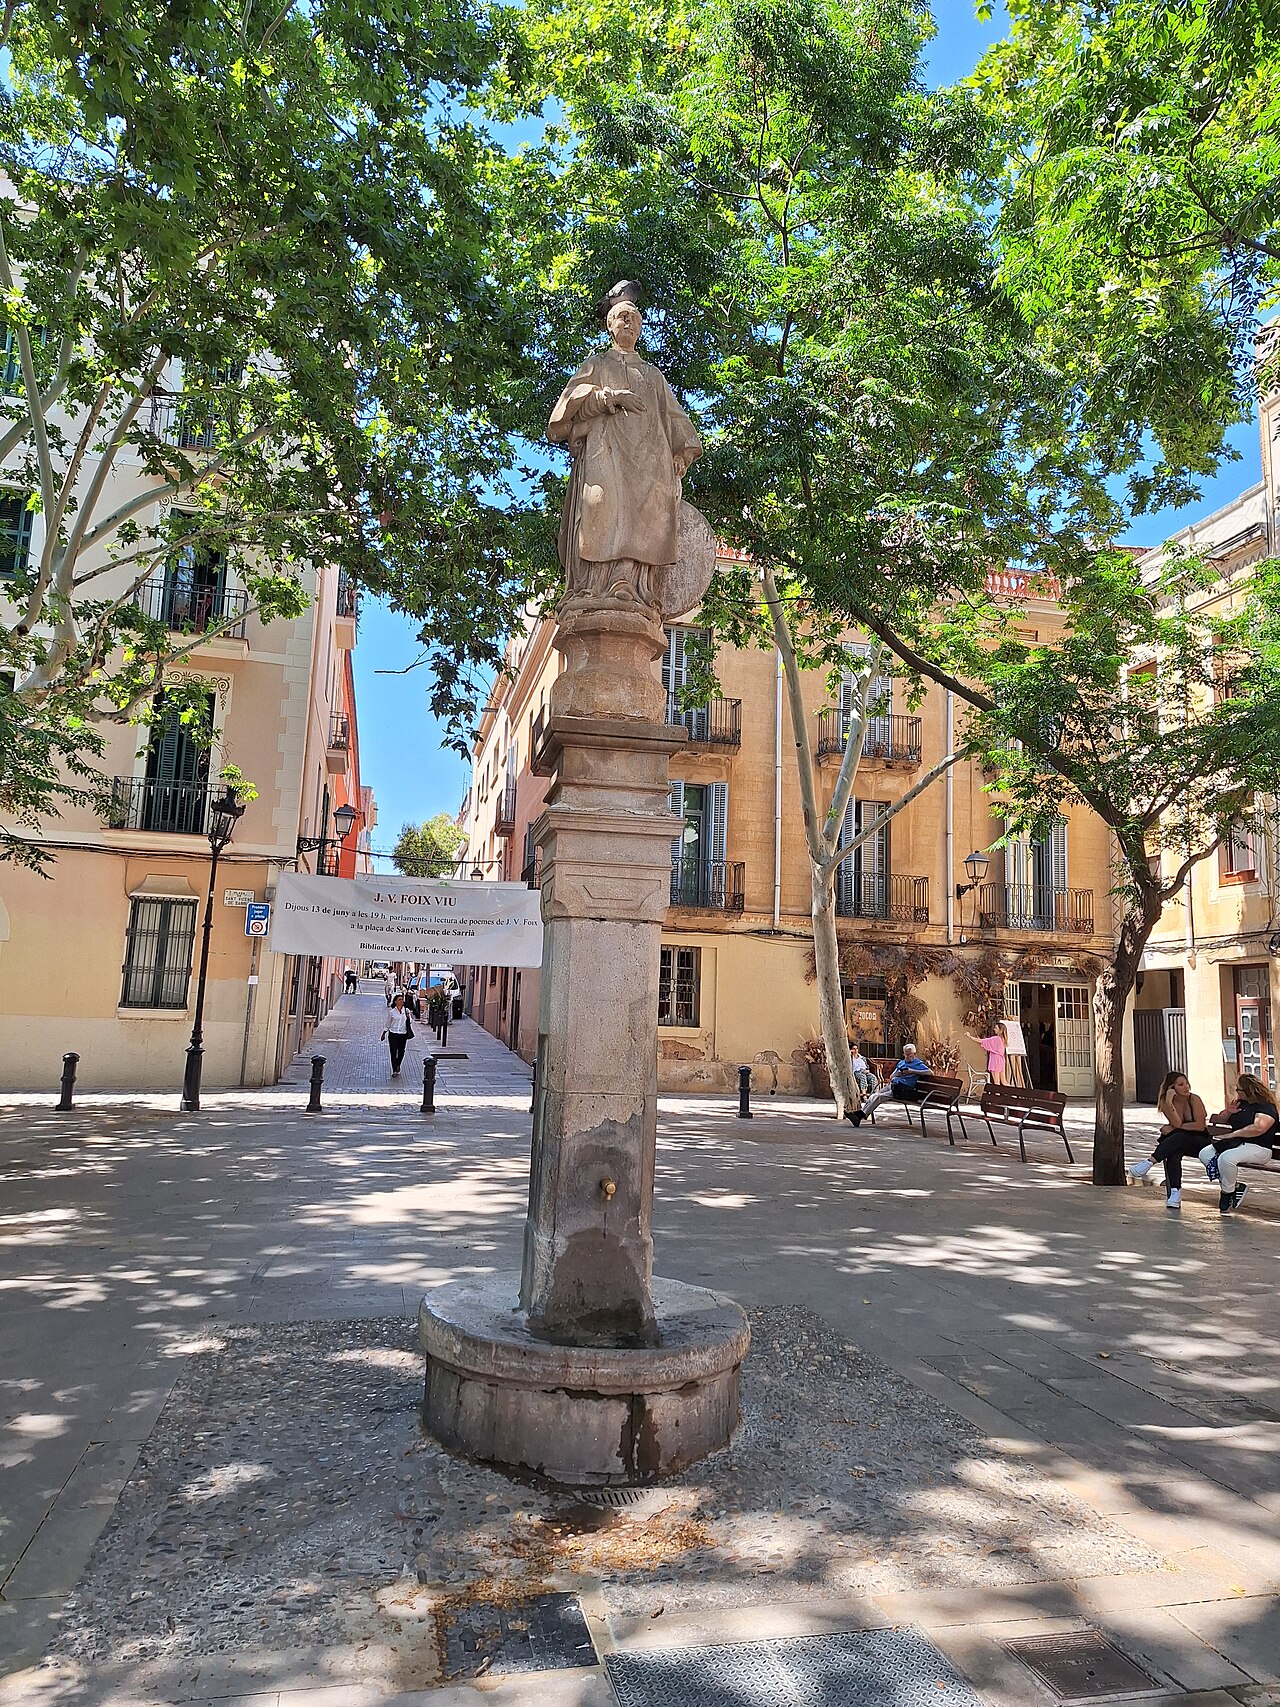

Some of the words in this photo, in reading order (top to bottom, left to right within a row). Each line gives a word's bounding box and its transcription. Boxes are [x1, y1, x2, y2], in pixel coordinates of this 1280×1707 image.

[374, 892, 384, 902] J.
[388, 894, 397, 903] V.
[401, 894, 431, 906] FOIX
[435, 896, 457, 906] VIU
[285, 902, 309, 912] Dijous
[332, 908, 350, 918] juny
[434, 915, 458, 924] lectura
[365, 923, 384, 932] plaça
[386, 924, 394, 932] de
[416, 927, 440, 936] Vicenç
[360, 943, 394, 951] Biblioteca
